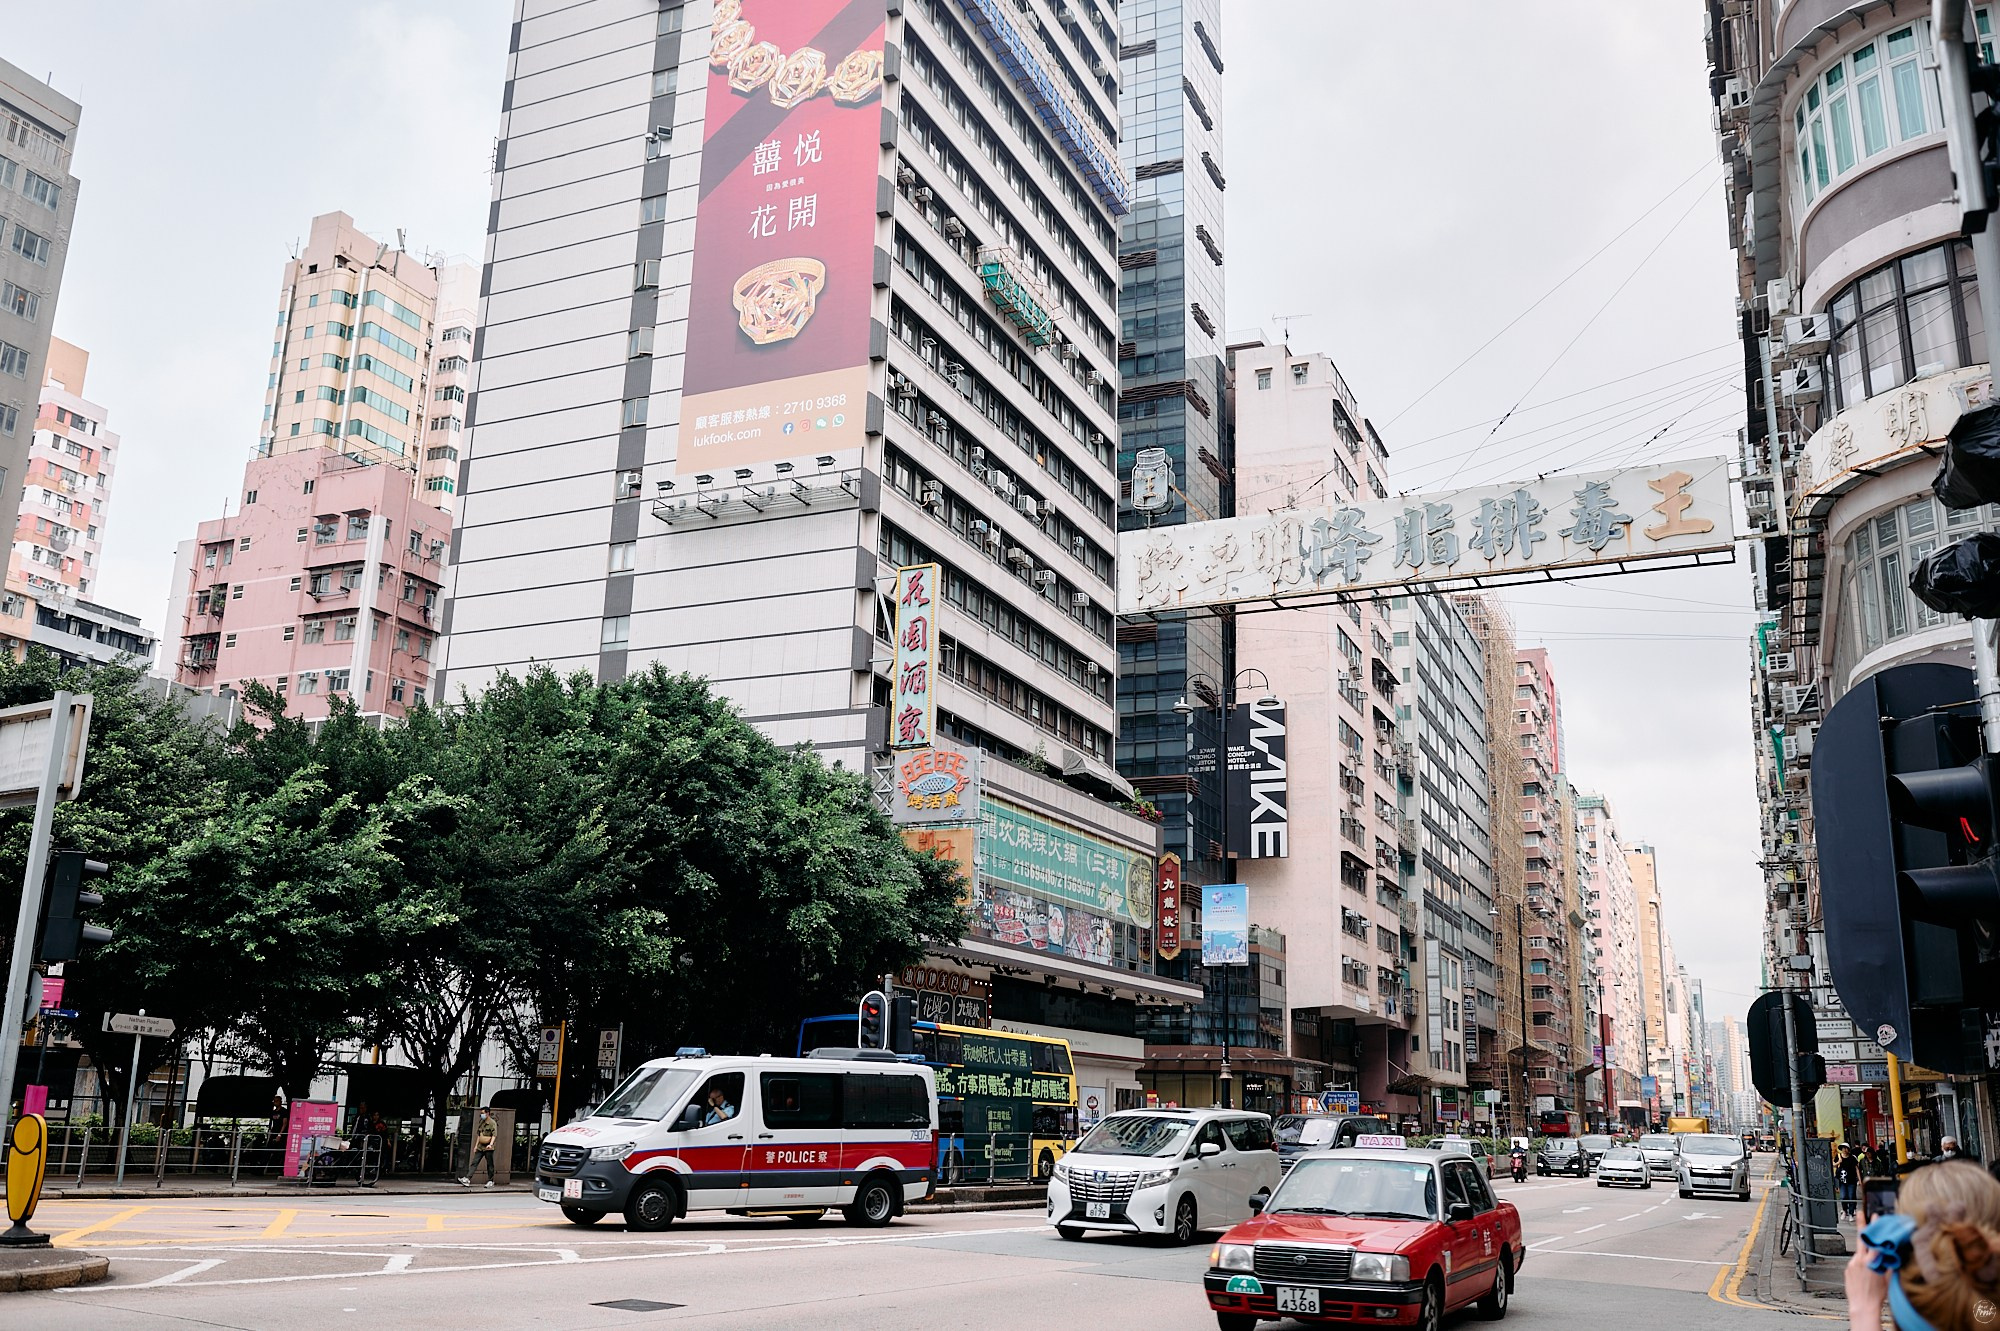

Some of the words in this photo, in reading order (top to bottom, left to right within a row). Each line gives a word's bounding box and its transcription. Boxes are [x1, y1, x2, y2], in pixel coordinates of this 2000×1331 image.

[748, 193, 818, 240] 花開
[783, 399, 814, 416] 2710
[816, 393, 847, 410] 9368
[693, 428, 762, 448] lukfook.com
[897, 569, 931, 744] 花園酒家
[901, 751, 968, 783] 旺旺
[1161, 878, 1176, 927] 九龍坎
[910, 1130, 926, 1141] 7907
[1359, 1136, 1401, 1146] TAXI
[766, 1151, 775, 1163] 警
[777, 1150, 816, 1163] POLICE
[818, 1151, 828, 1163] 察
[1093, 1202, 1104, 1210] XS
[1089, 1209, 1107, 1217] 8179
[1239, 1279, 1248, 1288] 4
[1289, 1288, 1308, 1300] TZ
[1281, 1300, 1317, 1313] 4368
